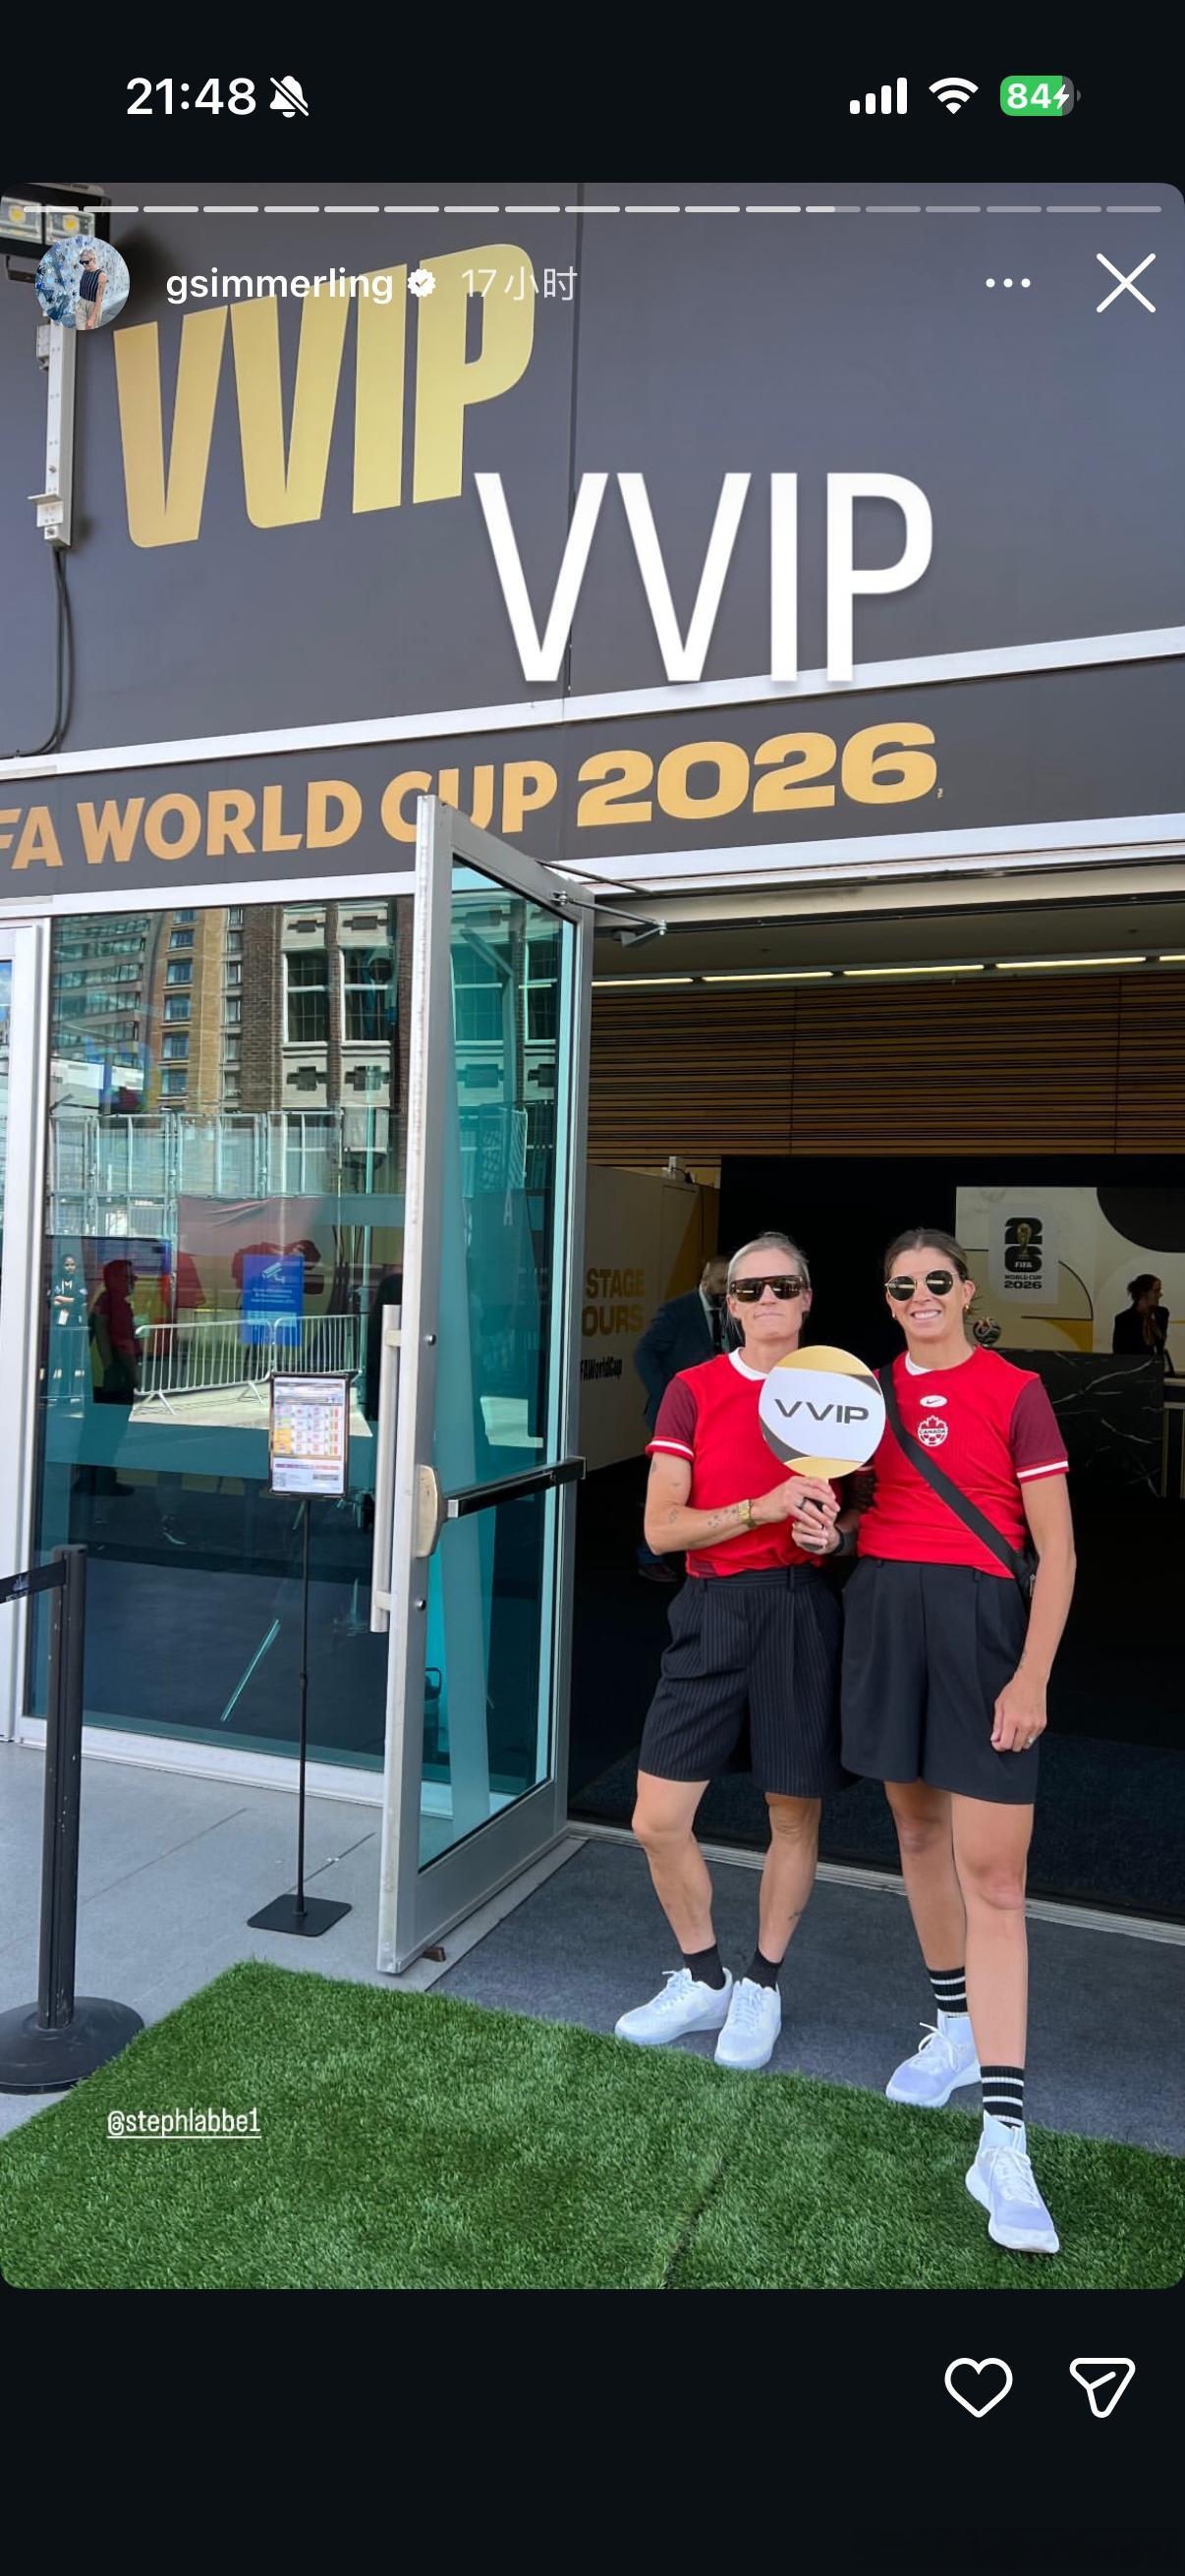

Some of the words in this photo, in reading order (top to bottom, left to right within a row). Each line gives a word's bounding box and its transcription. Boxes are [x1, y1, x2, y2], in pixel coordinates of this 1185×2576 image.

[113, 243, 536, 548] VVIP
[77, 779, 363, 865] WORLD
[379, 759, 558, 843] CUP
[577, 721, 938, 827] 2026
[586, 1267, 646, 1299] STAGE
[1004, 1280, 1043, 1290] 2026
[774, 1398, 870, 1424] VVIP
